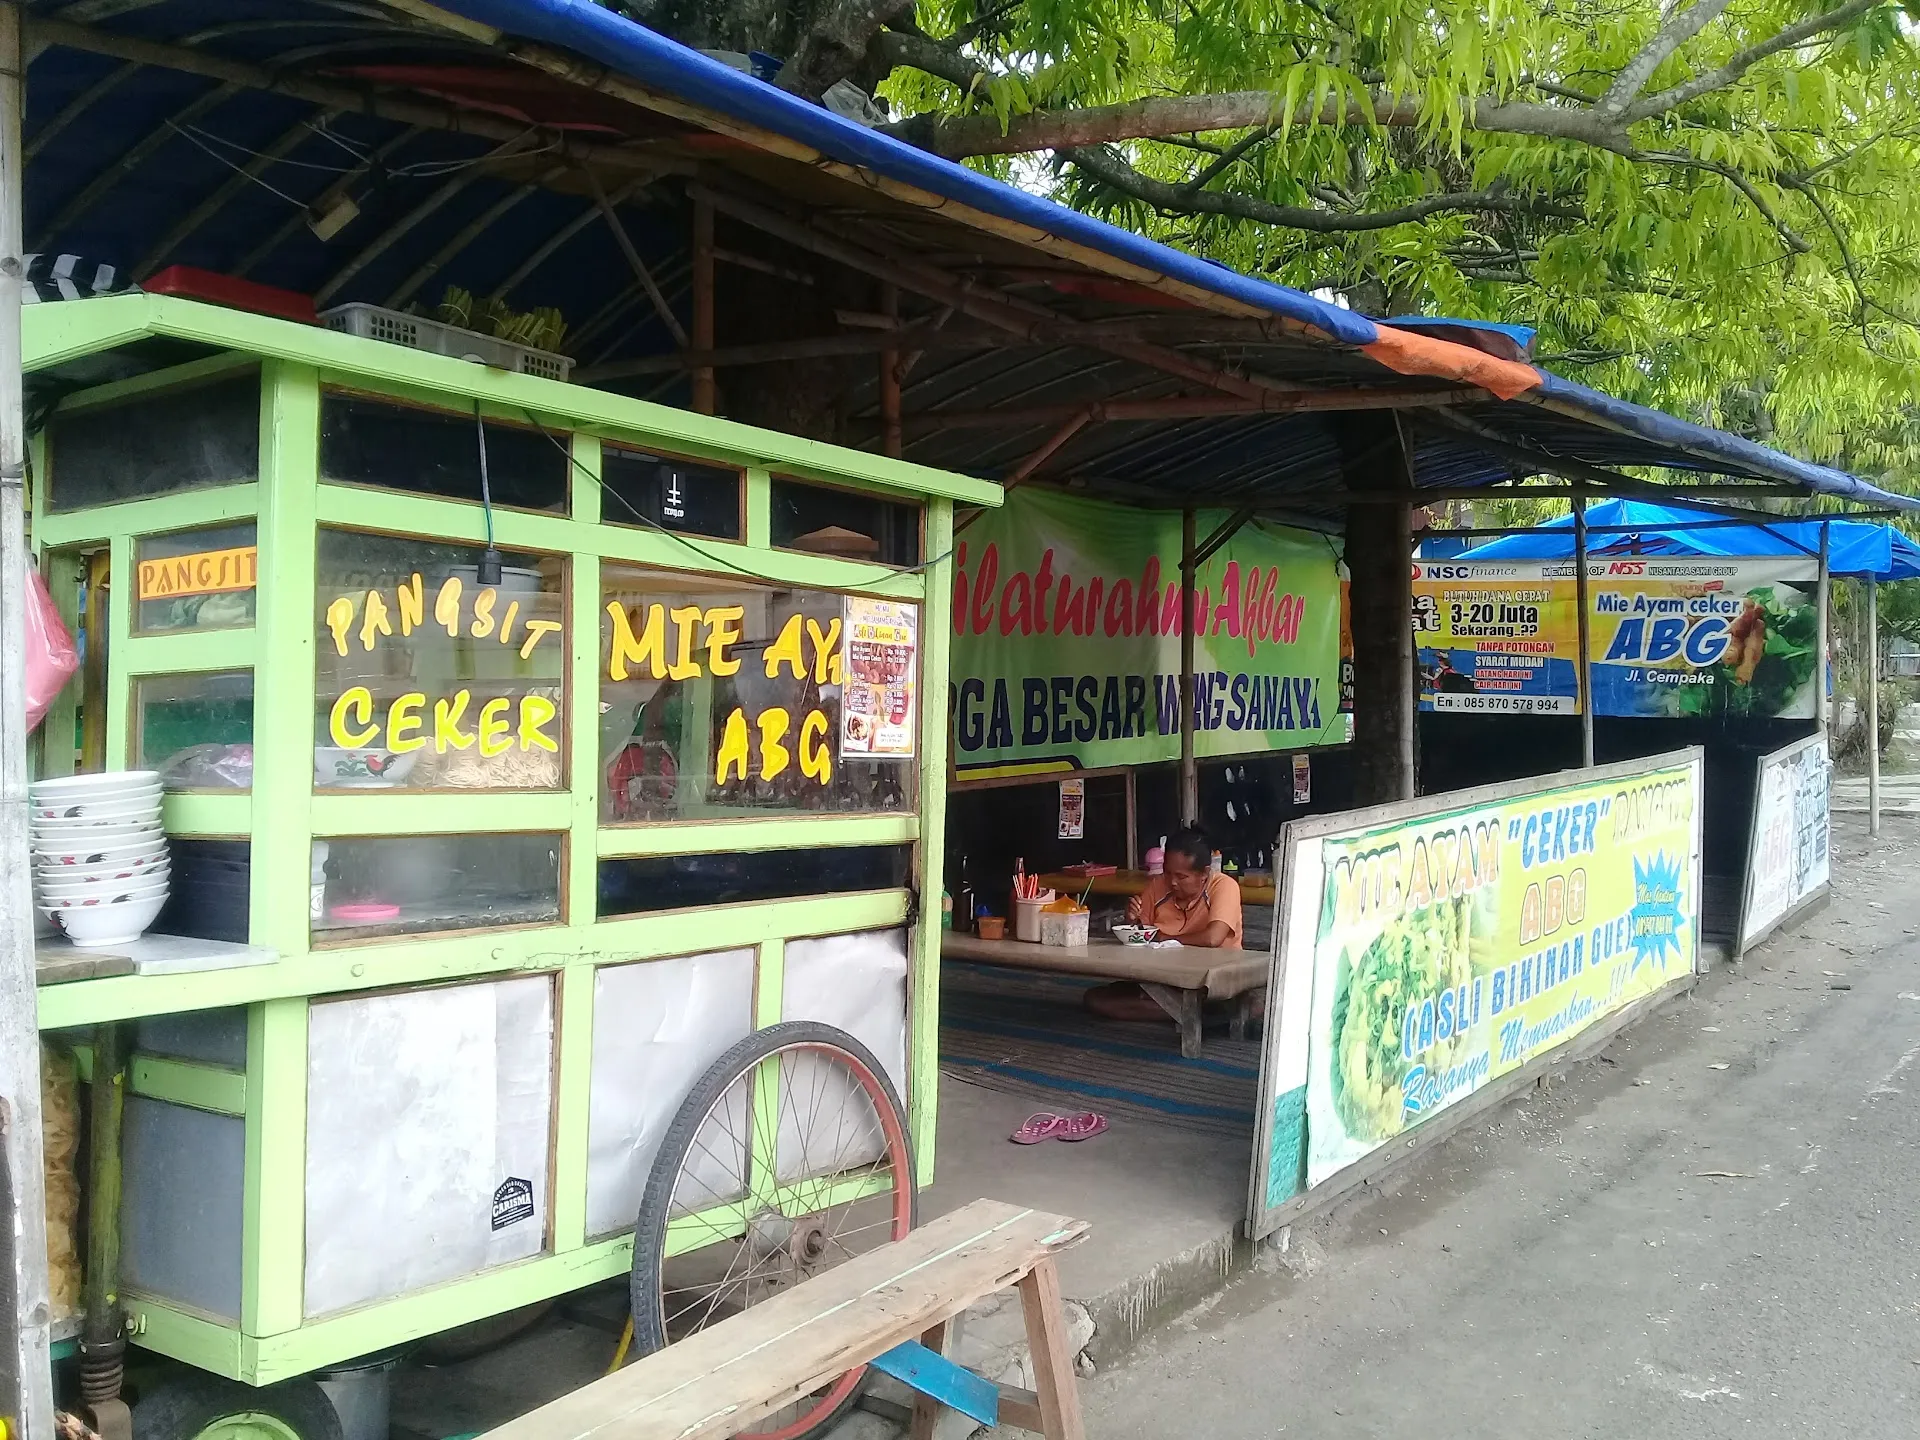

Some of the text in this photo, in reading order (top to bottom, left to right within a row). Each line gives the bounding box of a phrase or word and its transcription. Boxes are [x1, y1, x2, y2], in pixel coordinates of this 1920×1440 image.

[142, 552, 257, 594] PANGSIT
[1427, 565, 1517, 579] NSC finance
[1589, 566, 1605, 576] OF
[1648, 567, 1690, 576] NUSANTARA
[1690, 567, 1711, 576] SAKTI
[1712, 567, 1738, 576] GROUP
[1212, 561, 1305, 658] Akbar
[1443, 590, 1550, 602] BUTUH DANA CEPAT
[1597, 594, 1740, 617] Mie Ayam ceker
[325, 572, 562, 659] PANGSIT
[1451, 604, 1538, 623] 3-20 Juta
[606, 601, 744, 682] MIE
[1476, 642, 1555, 652] TANPA POTONGAN
[1604, 617, 1732, 666] ABG
[1475, 655, 1544, 668] SYARAT MUDAH
[1475, 669, 1532, 679] DATANG HARI INI
[1647, 670, 1715, 685] Cempaka
[1475, 681, 1521, 690] CAIR HARI INI
[1022, 676, 1145, 747] BESAR
[1437, 697, 1453, 707] Eni
[1464, 697, 1484, 708] 085
[1488, 699, 1509, 709] 870
[1512, 700, 1533, 710] 578
[330, 686, 559, 757] CEKER
[715, 707, 833, 786] ABG
[1334, 842, 1401, 924] MIE
[1404, 818, 1500, 911] AYAM
[1519, 868, 1587, 946] ABG
[1404, 912, 1631, 1059] (ASLI BIKINAN GUE)
[1401, 1050, 1490, 1126] Rasanya
[492, 1192, 532, 1218] CARISMA
